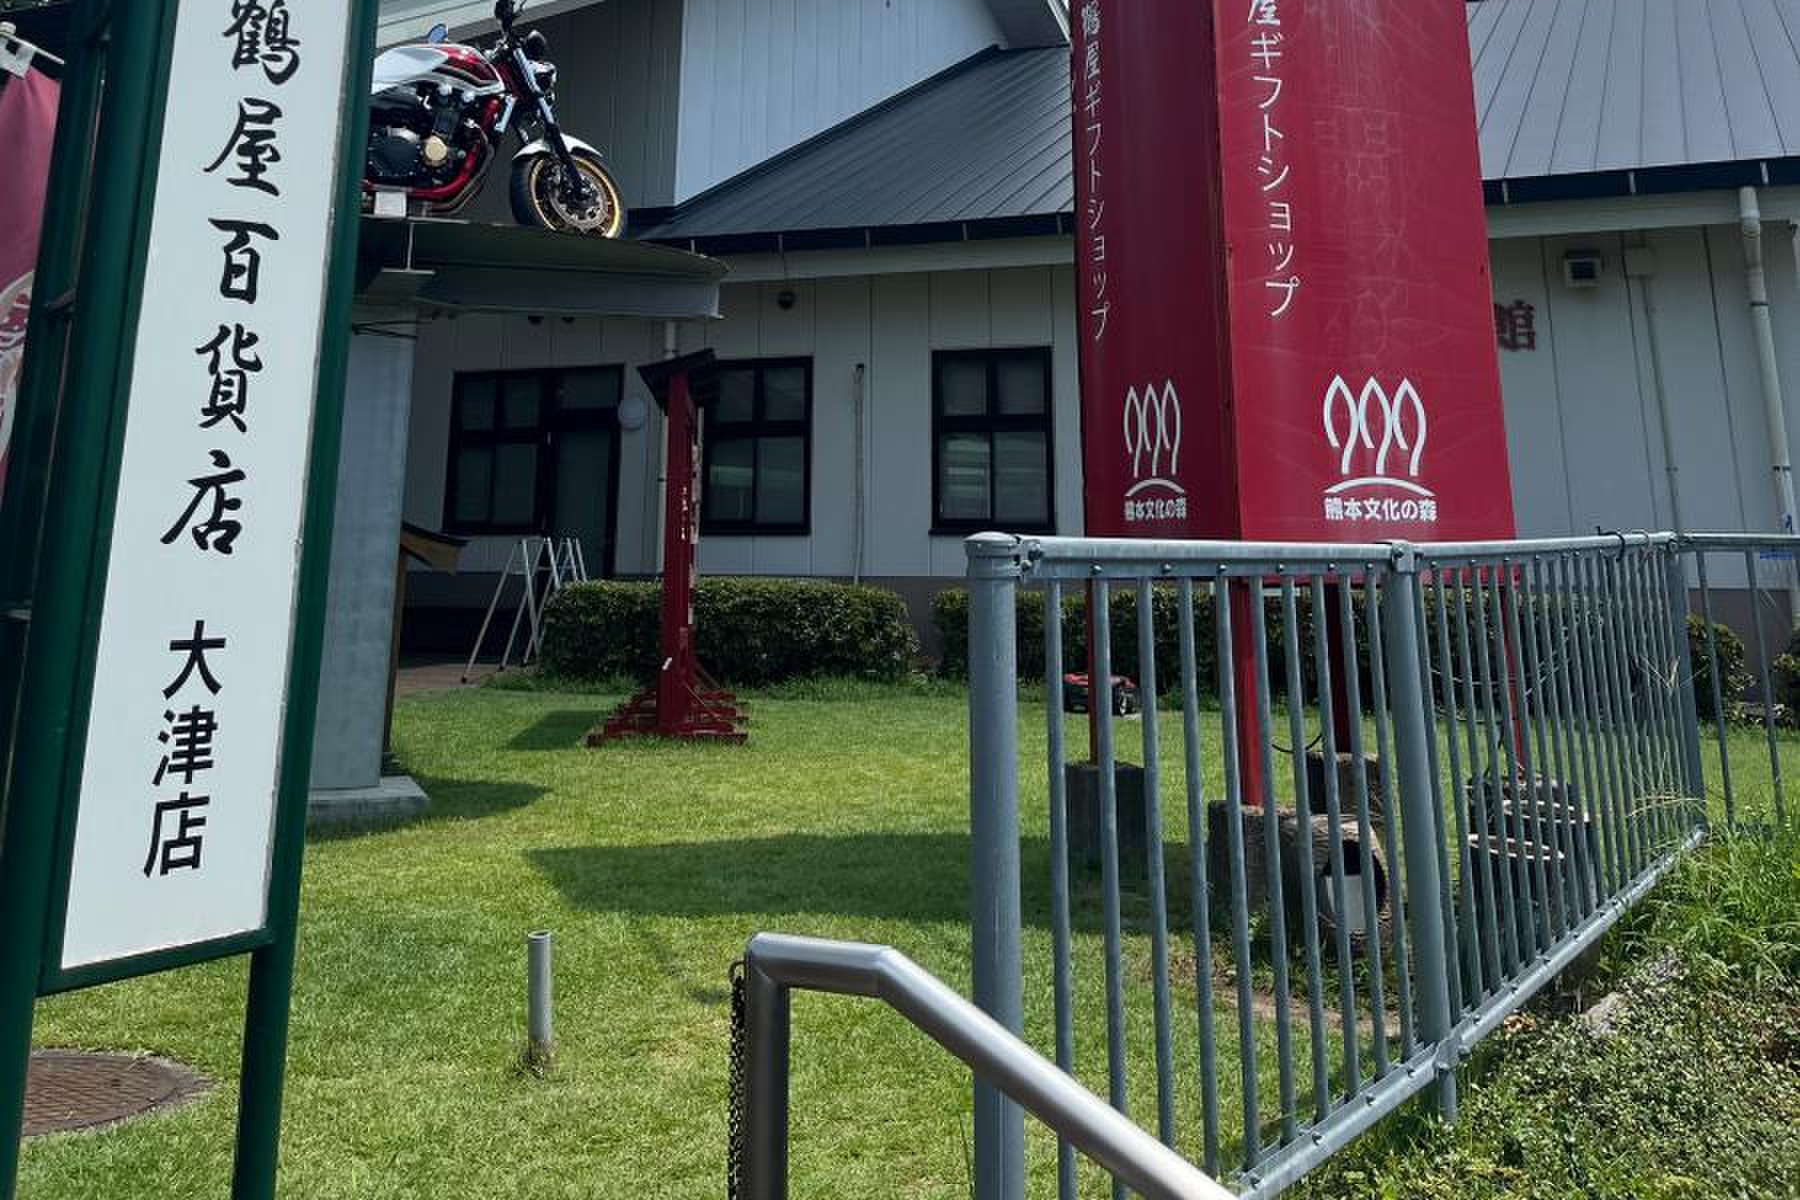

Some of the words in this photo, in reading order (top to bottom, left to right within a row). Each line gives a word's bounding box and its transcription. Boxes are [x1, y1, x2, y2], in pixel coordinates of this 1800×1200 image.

[1323, 497, 1438, 522] 熊本文化の森
[142, 619, 227, 878] 大津店
